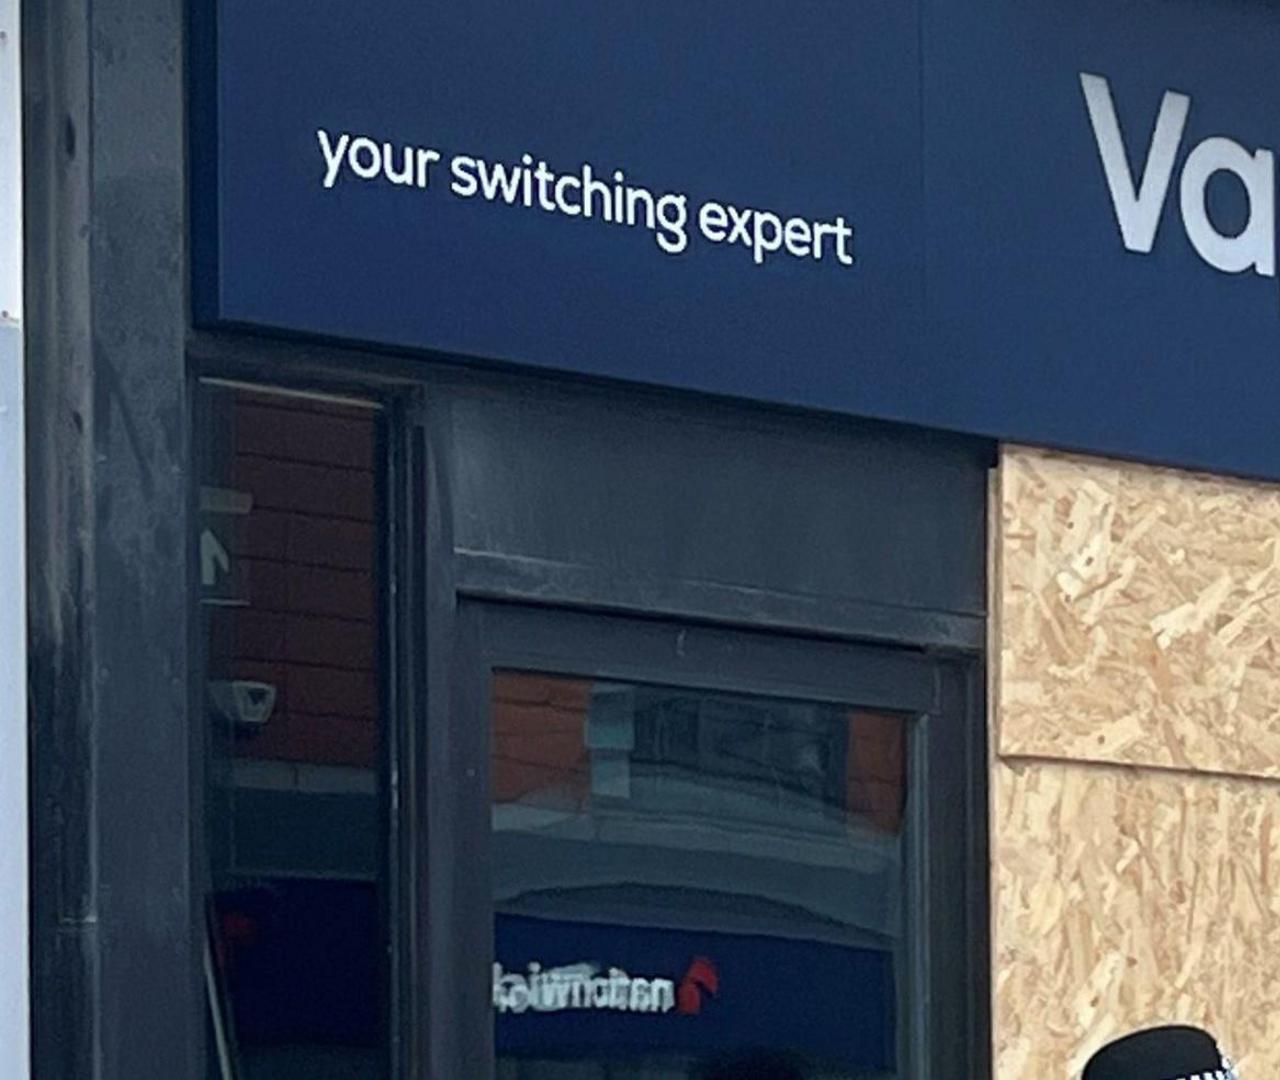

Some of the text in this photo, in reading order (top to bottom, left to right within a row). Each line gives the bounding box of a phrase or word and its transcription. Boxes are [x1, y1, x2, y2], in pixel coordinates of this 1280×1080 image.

[317, 129, 853, 265] your switching expert
